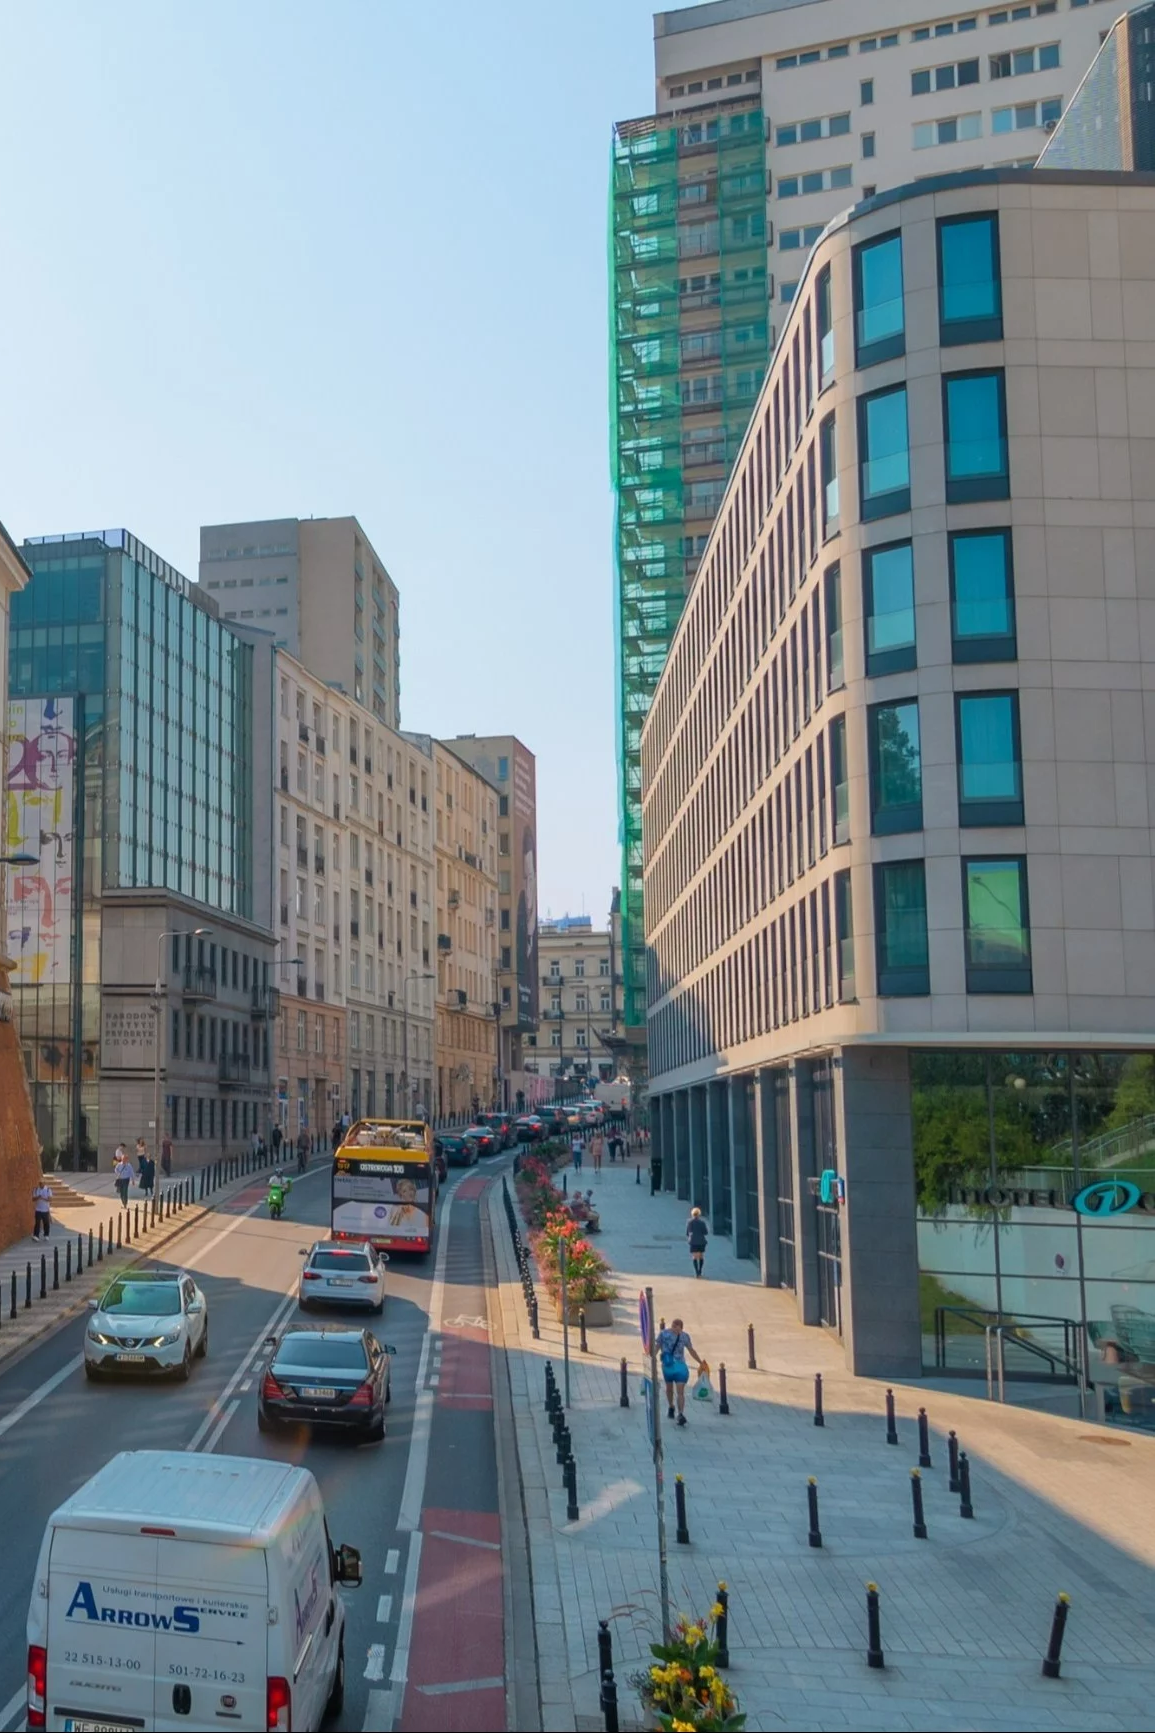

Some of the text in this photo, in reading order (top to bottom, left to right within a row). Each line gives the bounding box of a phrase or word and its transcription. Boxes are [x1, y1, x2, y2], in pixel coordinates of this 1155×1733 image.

[106, 1012, 156, 1020] NARODOW
[106, 1021, 155, 1029] INSTYTU
[65, 1651, 141, 1671] 22 515-13-00
[169, 1664, 246, 1684] 501-72-16-23
